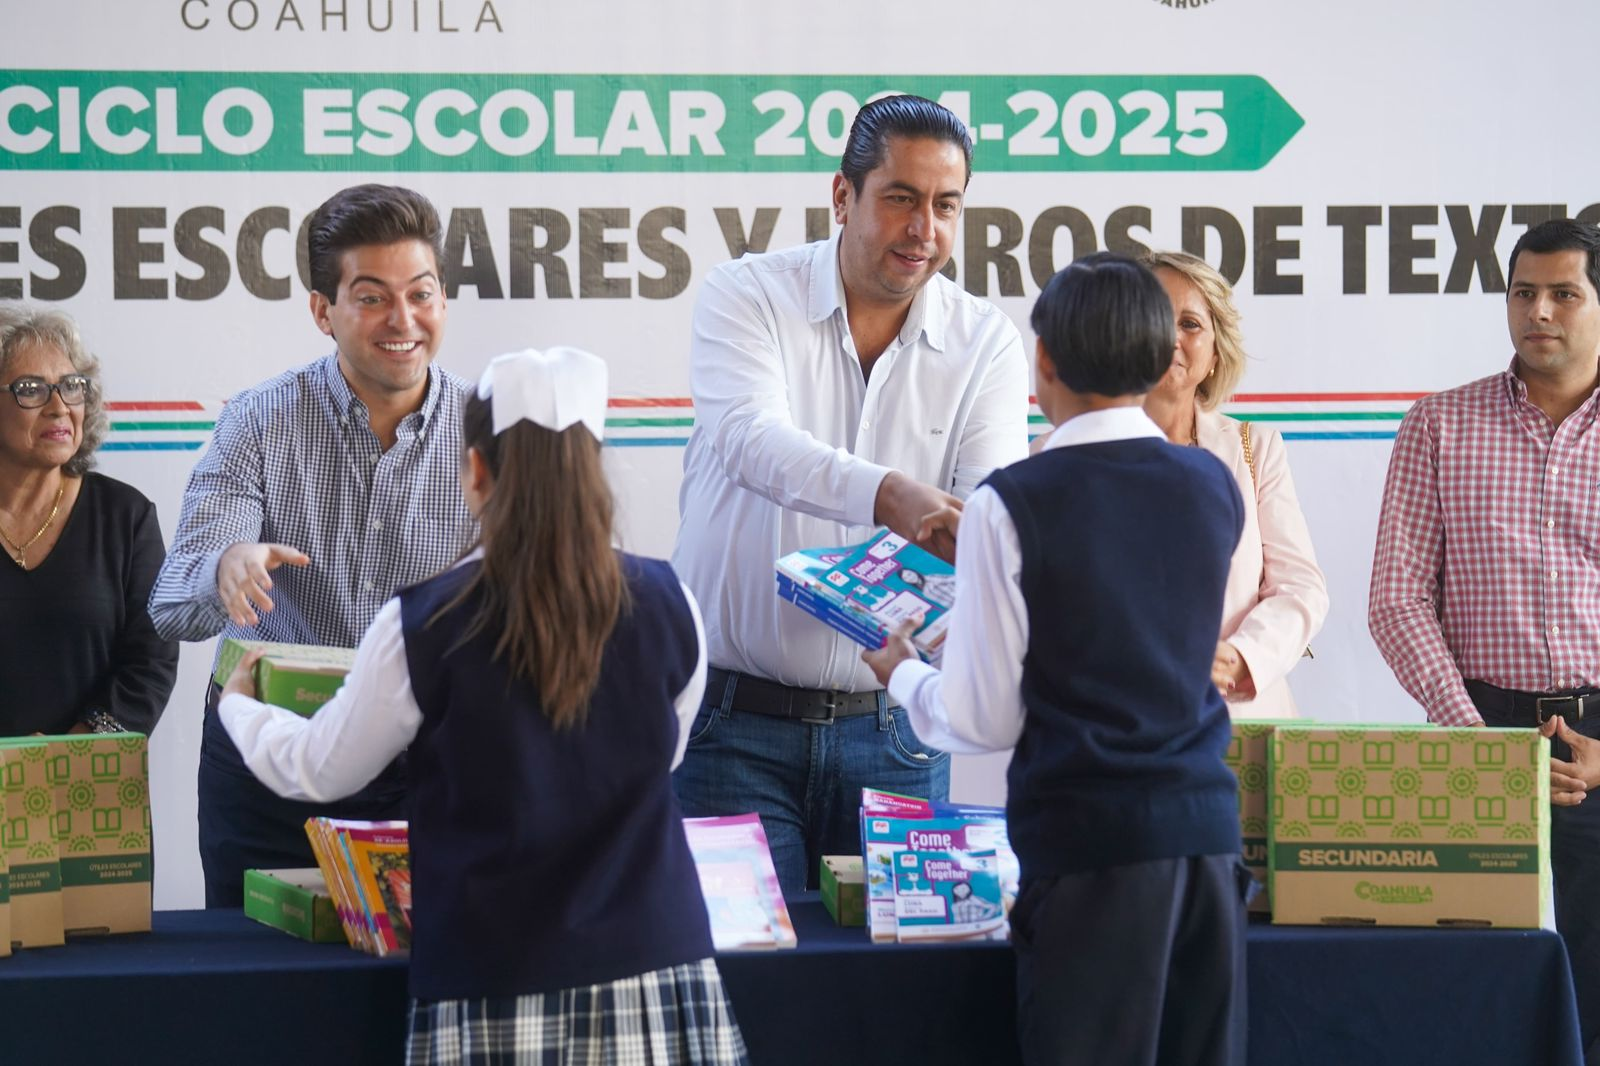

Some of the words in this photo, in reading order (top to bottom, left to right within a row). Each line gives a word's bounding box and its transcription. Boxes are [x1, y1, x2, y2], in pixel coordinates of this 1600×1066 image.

[181, 0, 503, 32] COAHUILA
[0, 85, 274, 156] CICLO
[303, 88, 726, 157] ESCOLAR
[752, 89, 1228, 157] 20-2025
[112, 205, 692, 301] ESCARES
[714, 207, 782, 260] Y
[1181, 206, 1303, 295] DE
[1326, 204, 1600, 294] TEX
[909, 830, 951, 847] Come
[924, 860, 952, 870] Come
[1298, 849, 1439, 867] SECUNDARIA
[927, 869, 969, 879] Together
[1354, 881, 1434, 899] COAHUILA
